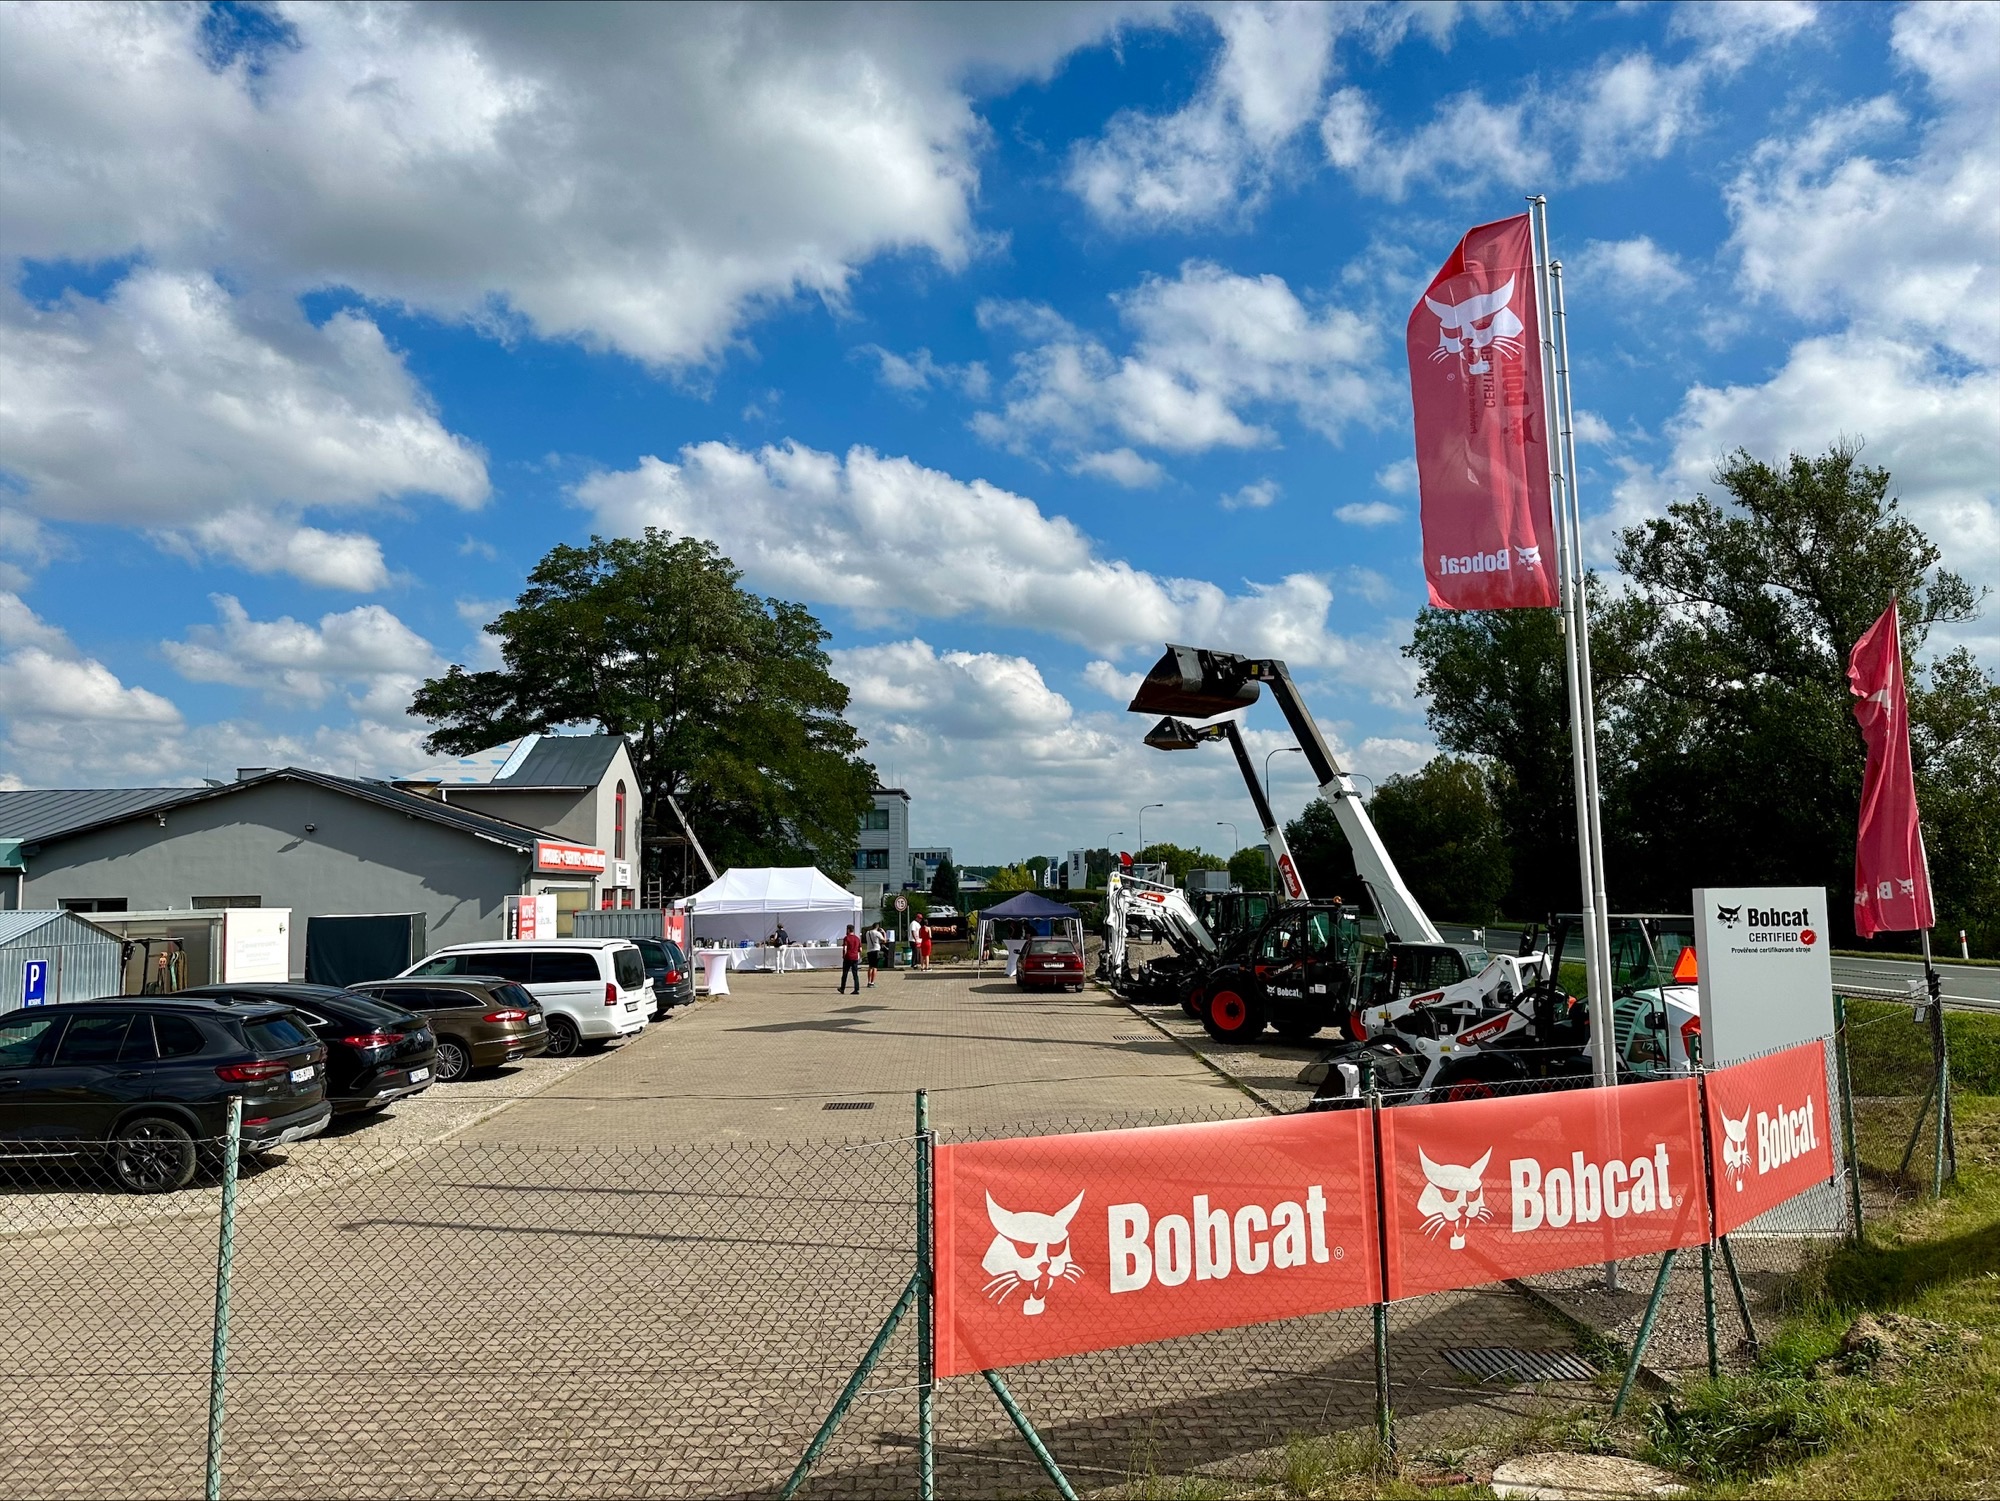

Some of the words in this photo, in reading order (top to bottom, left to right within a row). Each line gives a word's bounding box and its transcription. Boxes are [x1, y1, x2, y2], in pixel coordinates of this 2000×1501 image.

[897, 900, 905, 908] 15
[1748, 908, 1809, 926] Bobcat
[1749, 932, 1797, 942] CERTIFIED
[30, 965, 40, 992] P
[1277, 987, 1299, 998] Bobcat
[1475, 1026, 1497, 1041] Bobcat
[1756, 1095, 1817, 1175] Bobcat
[1510, 1143, 1675, 1233] Bobcat
[1107, 1185, 1329, 1294] Bobcat
